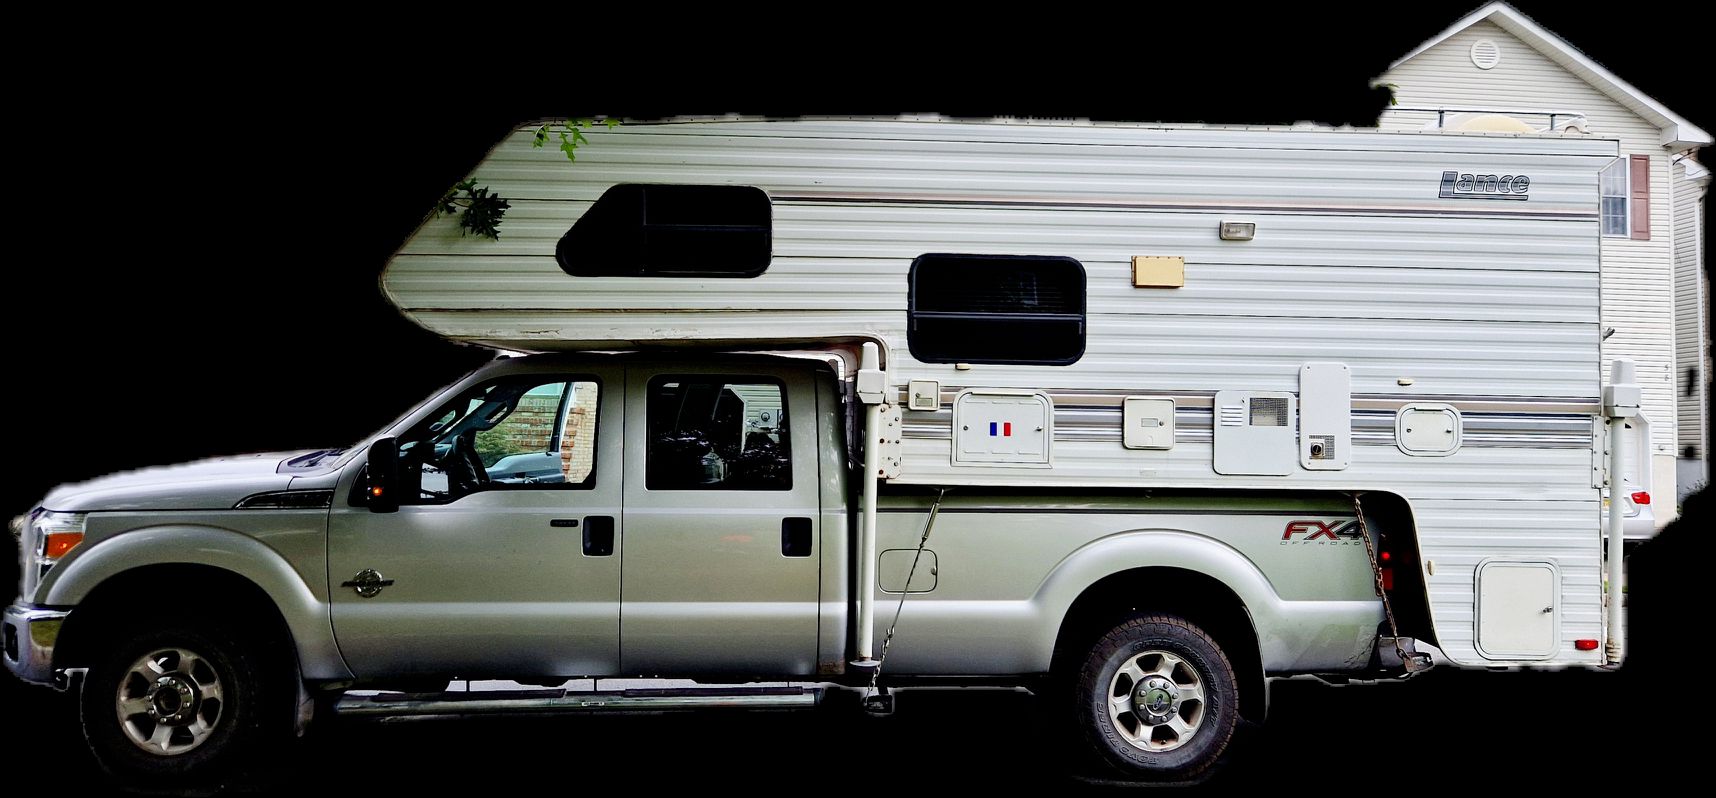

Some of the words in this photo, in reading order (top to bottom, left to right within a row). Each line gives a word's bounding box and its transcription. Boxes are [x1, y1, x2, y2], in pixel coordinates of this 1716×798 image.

[1439, 171, 1530, 201] Lance
[1282, 520, 1361, 540] FX4
[1119, 746, 1158, 764] TOYO
